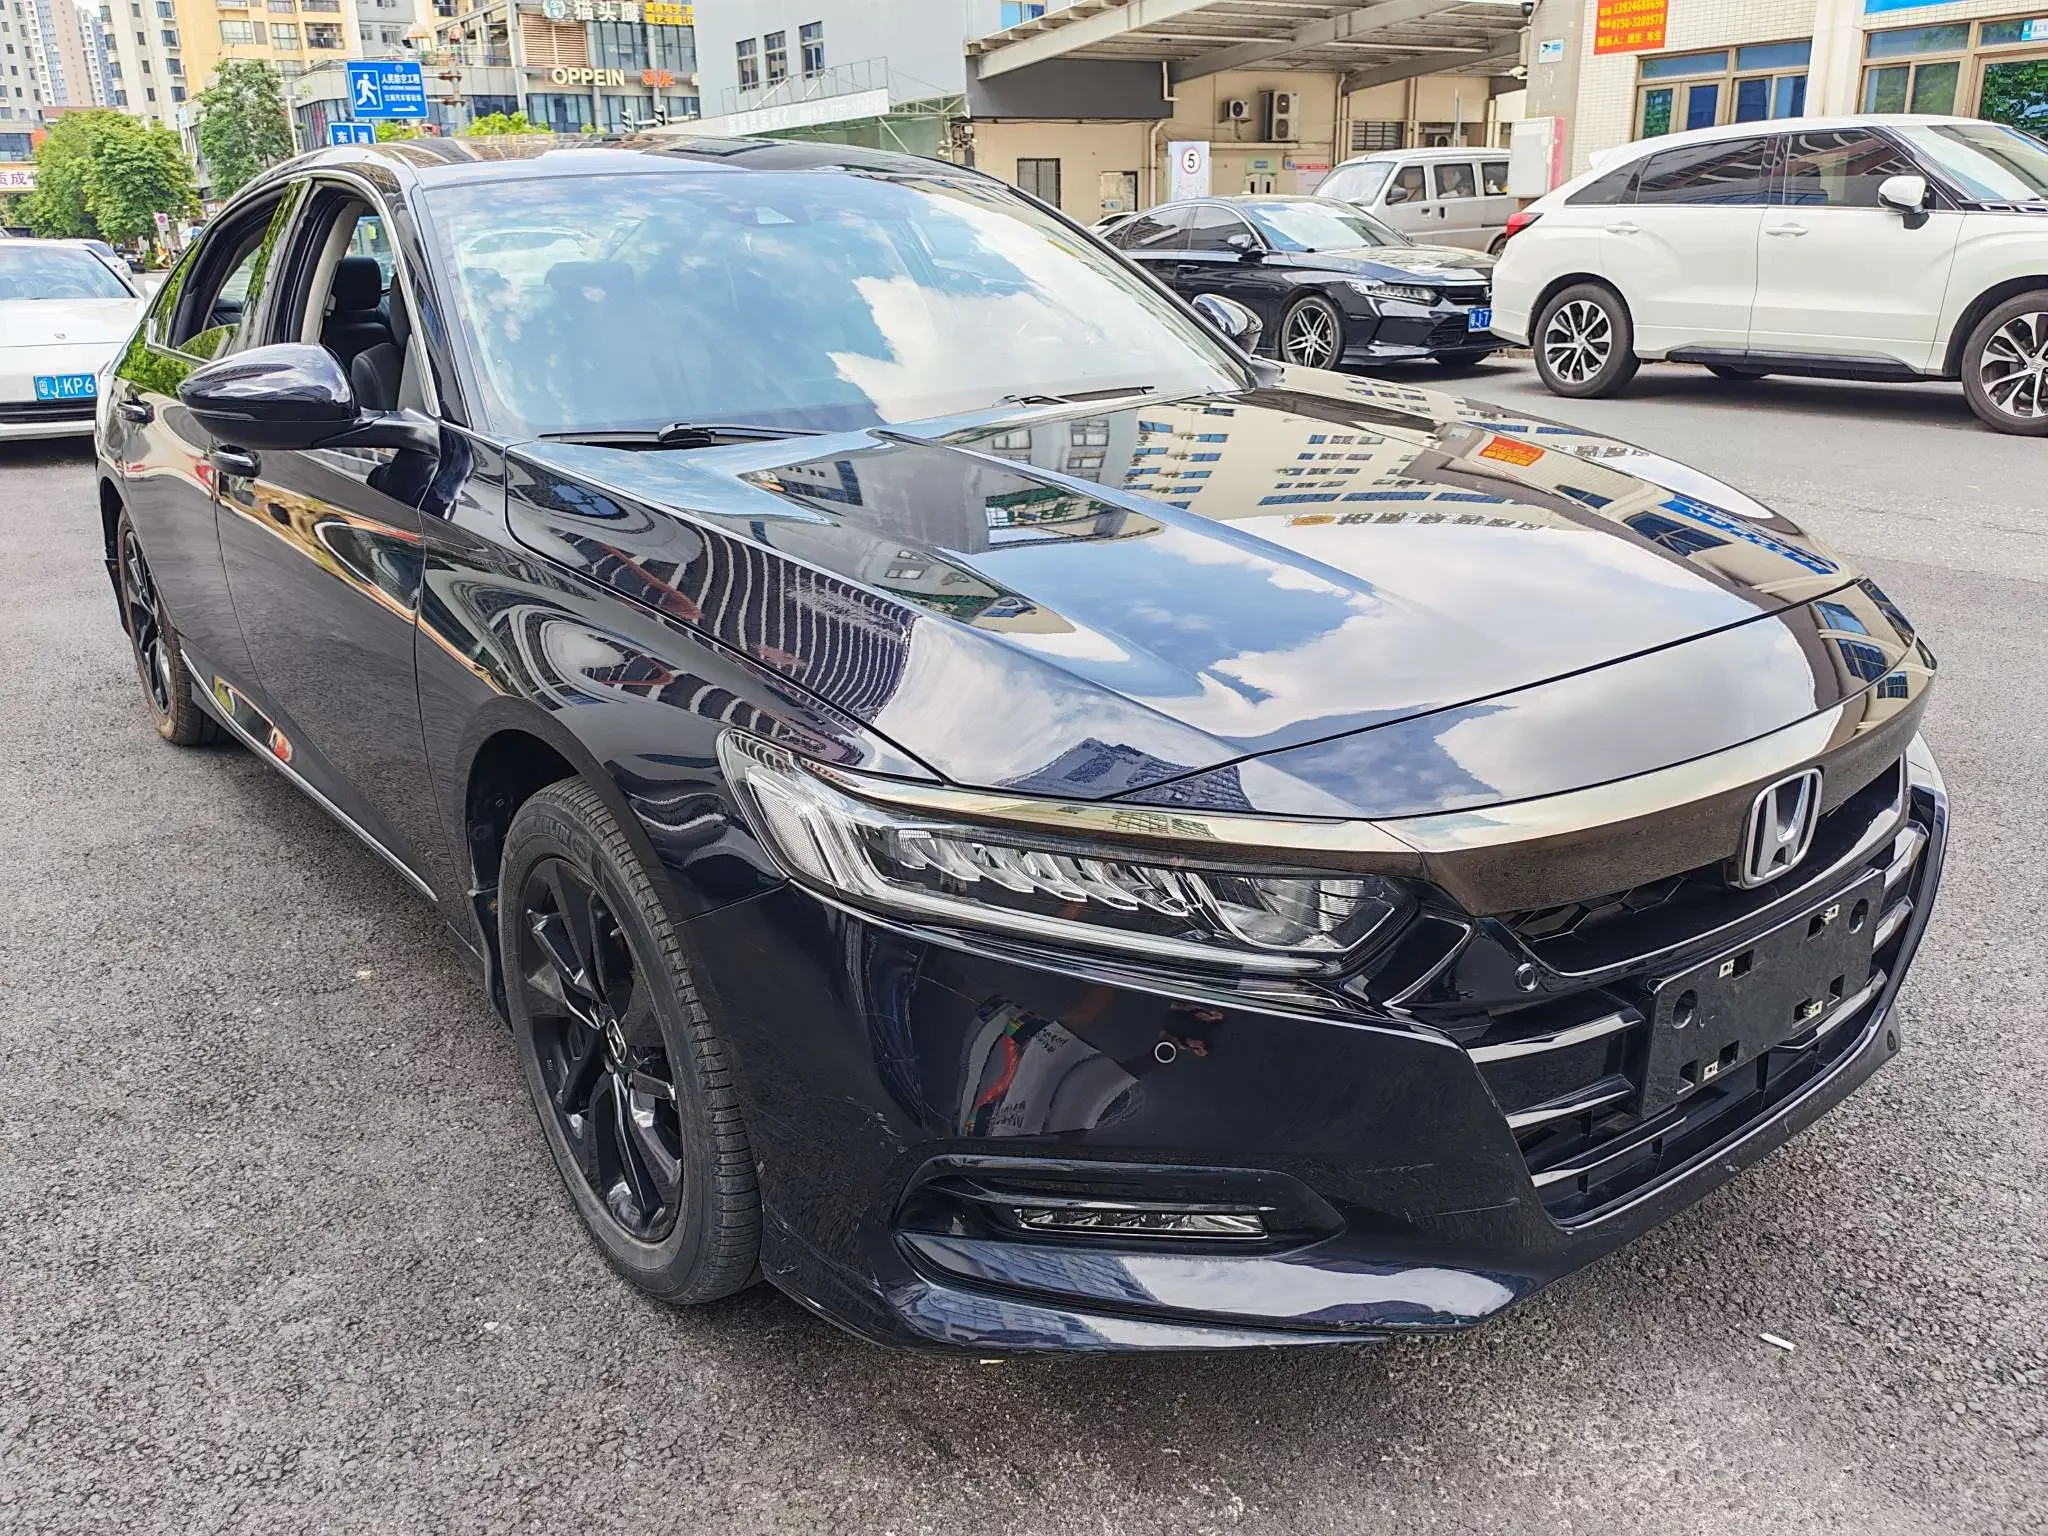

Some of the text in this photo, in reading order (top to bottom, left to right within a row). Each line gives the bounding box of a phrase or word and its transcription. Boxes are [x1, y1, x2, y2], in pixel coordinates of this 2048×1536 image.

[574, 0, 640, 23] 猫头鹰
[551, 68, 625, 87] OPPEIN
[336, 131, 349, 143] 东
[1187, 153, 1196, 169] 5
